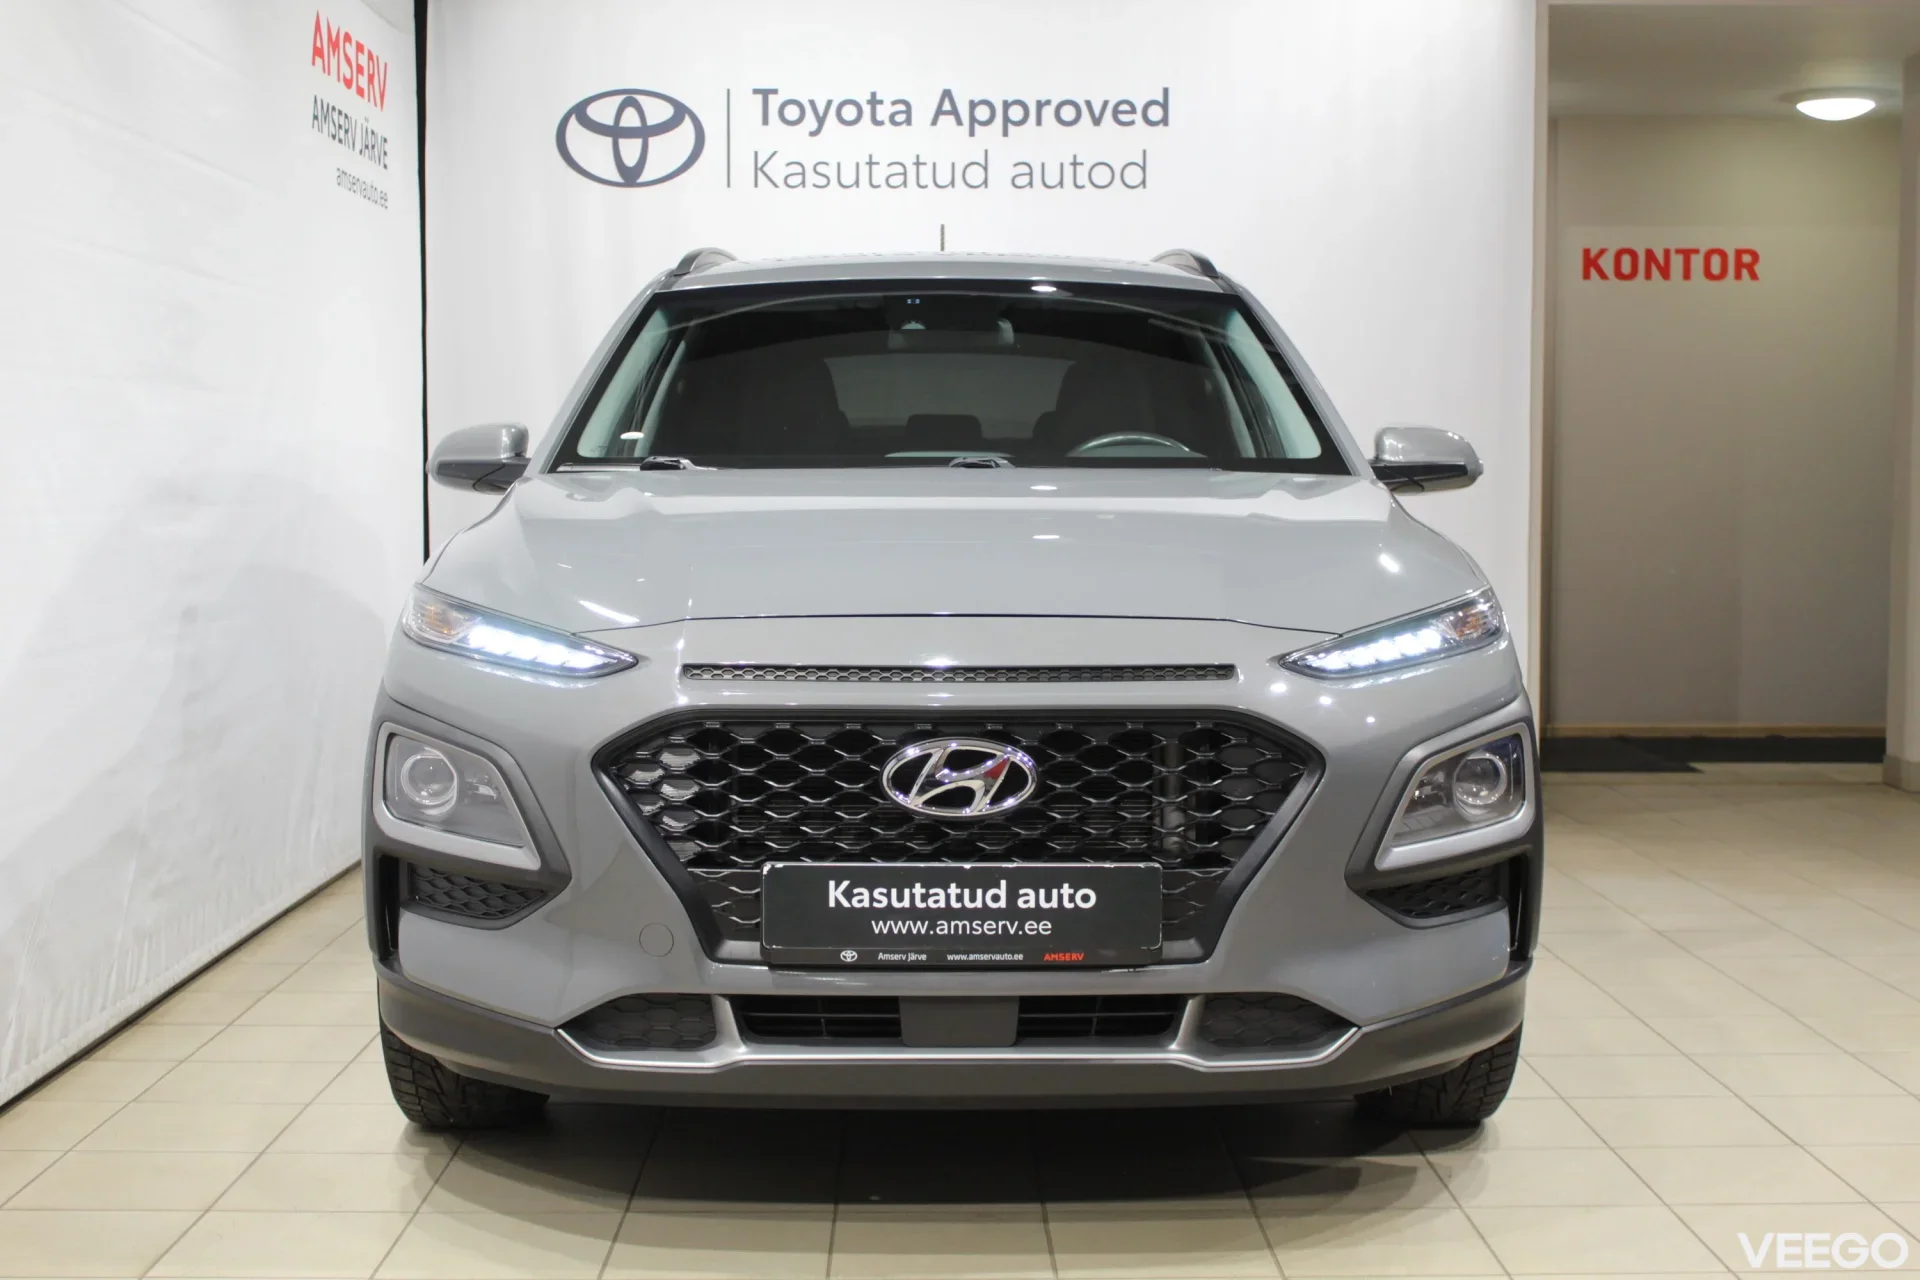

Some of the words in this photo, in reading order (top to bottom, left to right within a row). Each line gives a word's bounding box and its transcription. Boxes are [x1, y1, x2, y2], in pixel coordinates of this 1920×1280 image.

[311, 10, 388, 112] AMSERV
[752, 88, 913, 137] Toyota
[930, 87, 1171, 137] Approved
[311, 94, 358, 152] AMSERV
[358, 116, 388, 170] JÄRVE
[753, 149, 989, 190] Kasutatud
[1010, 149, 1148, 190] autod
[335, 167, 388, 210] amservauto.ee
[1582, 247, 1760, 281] KONTOR
[828, 880, 1007, 909] Kasutatud
[1016, 883, 1097, 909] auto
[871, 919, 1052, 935] www.amserv.ee
[877, 952, 906, 962] Amserv
[907, 952, 927, 962] Järve
[946, 952, 1024, 962] www.amservauto.ee
[1043, 952, 1085, 962] AMSERV
